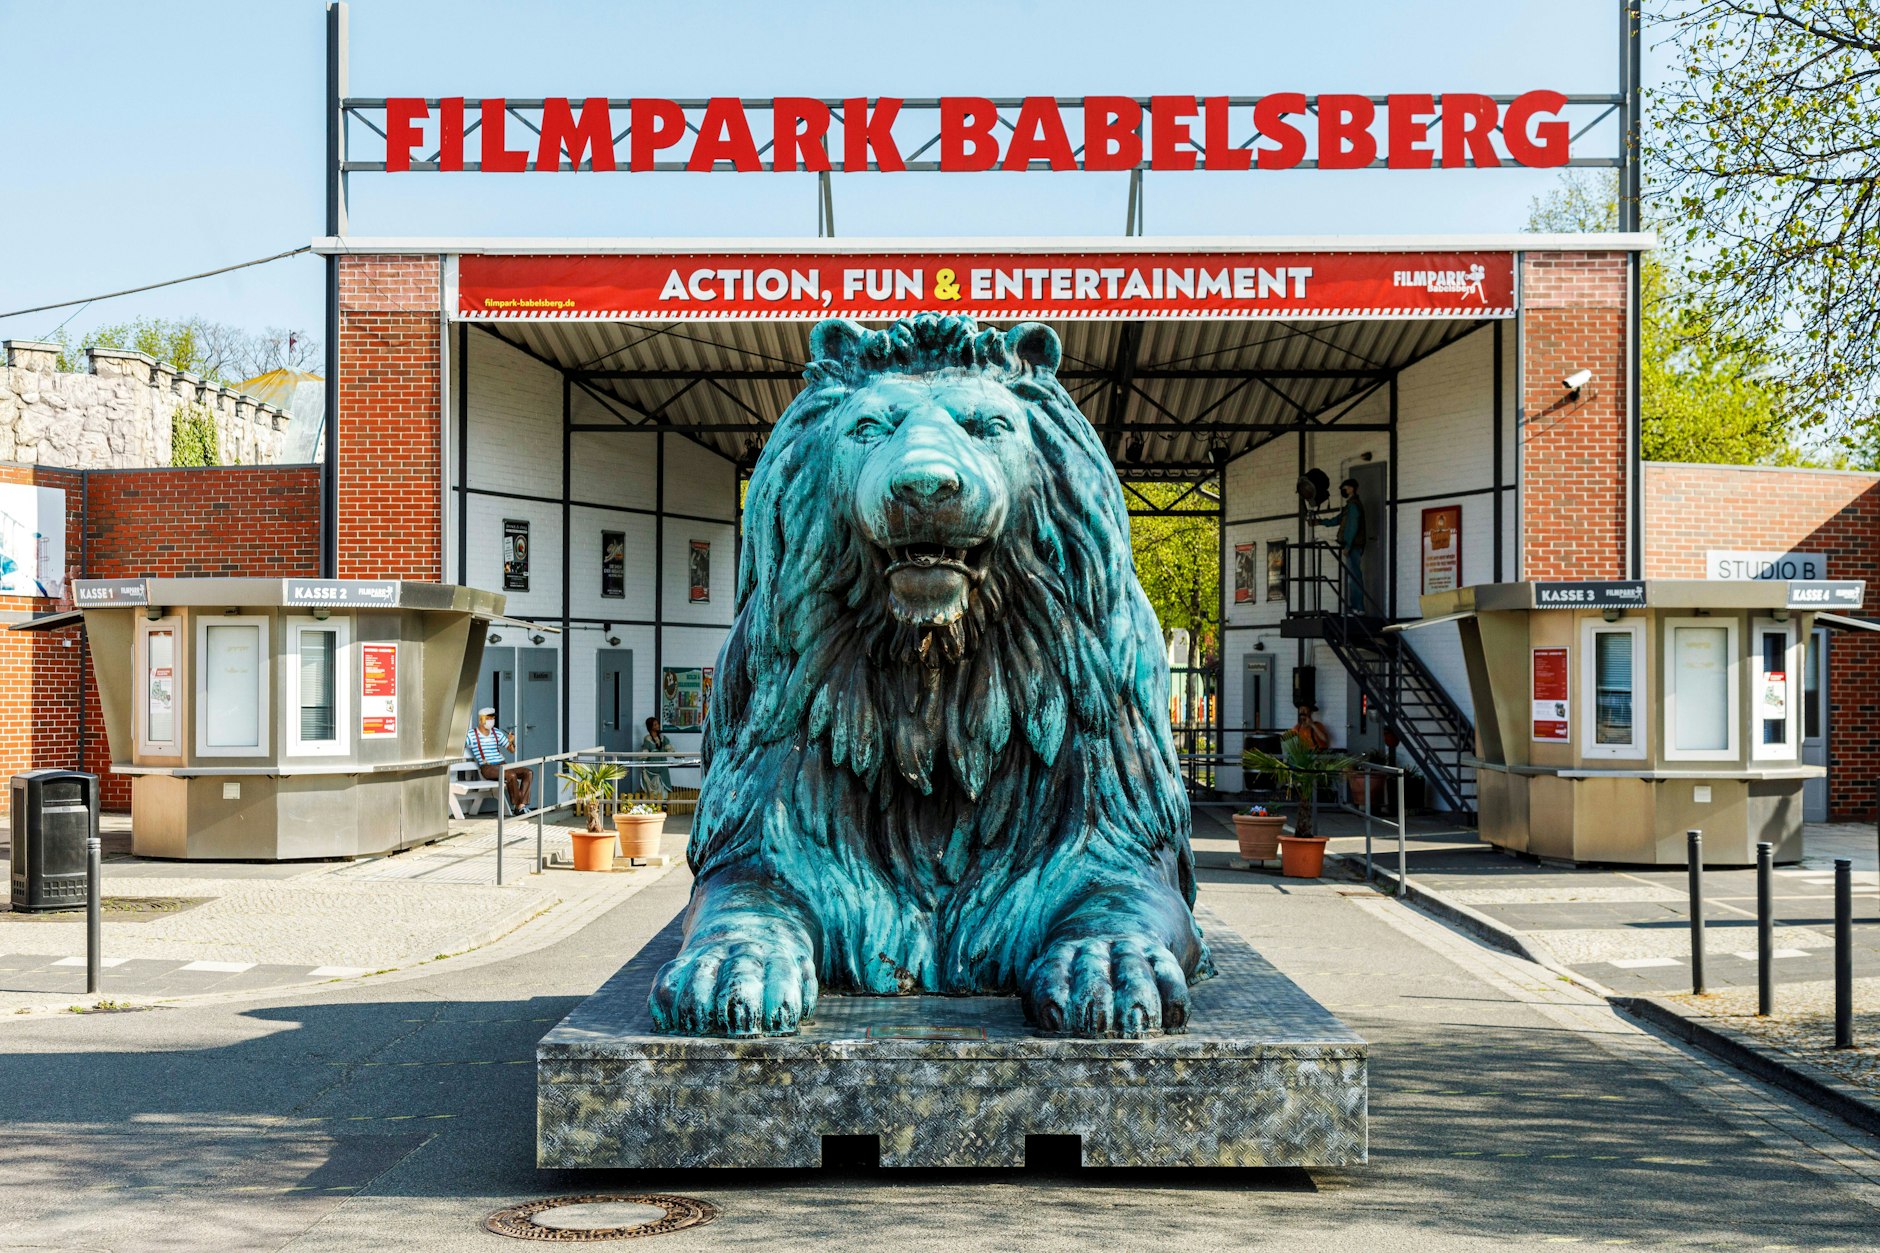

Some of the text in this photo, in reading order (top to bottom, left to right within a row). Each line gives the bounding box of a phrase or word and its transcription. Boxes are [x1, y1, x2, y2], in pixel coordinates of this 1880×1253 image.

[386, 90, 1570, 173] FILMPARK BABELSBERG
[1393, 270, 1466, 287] FILMPARK
[659, 266, 1314, 307] ACTION, FUN & ENTERTAINMENT
[1427, 284, 1476, 295] Babelsberg
[484, 298, 575, 309] filmpark-babelsberg.de
[1718, 560, 1816, 580] STUDIO B
[80, 588, 113, 599] KASSE 1
[295, 587, 347, 599] KASSE 2
[1541, 589, 1595, 602] KASSE 3
[1606, 589, 1636, 597] FILMPARK
[1793, 589, 1823, 601] KASSE
[1823, 589, 1830, 601] 4
